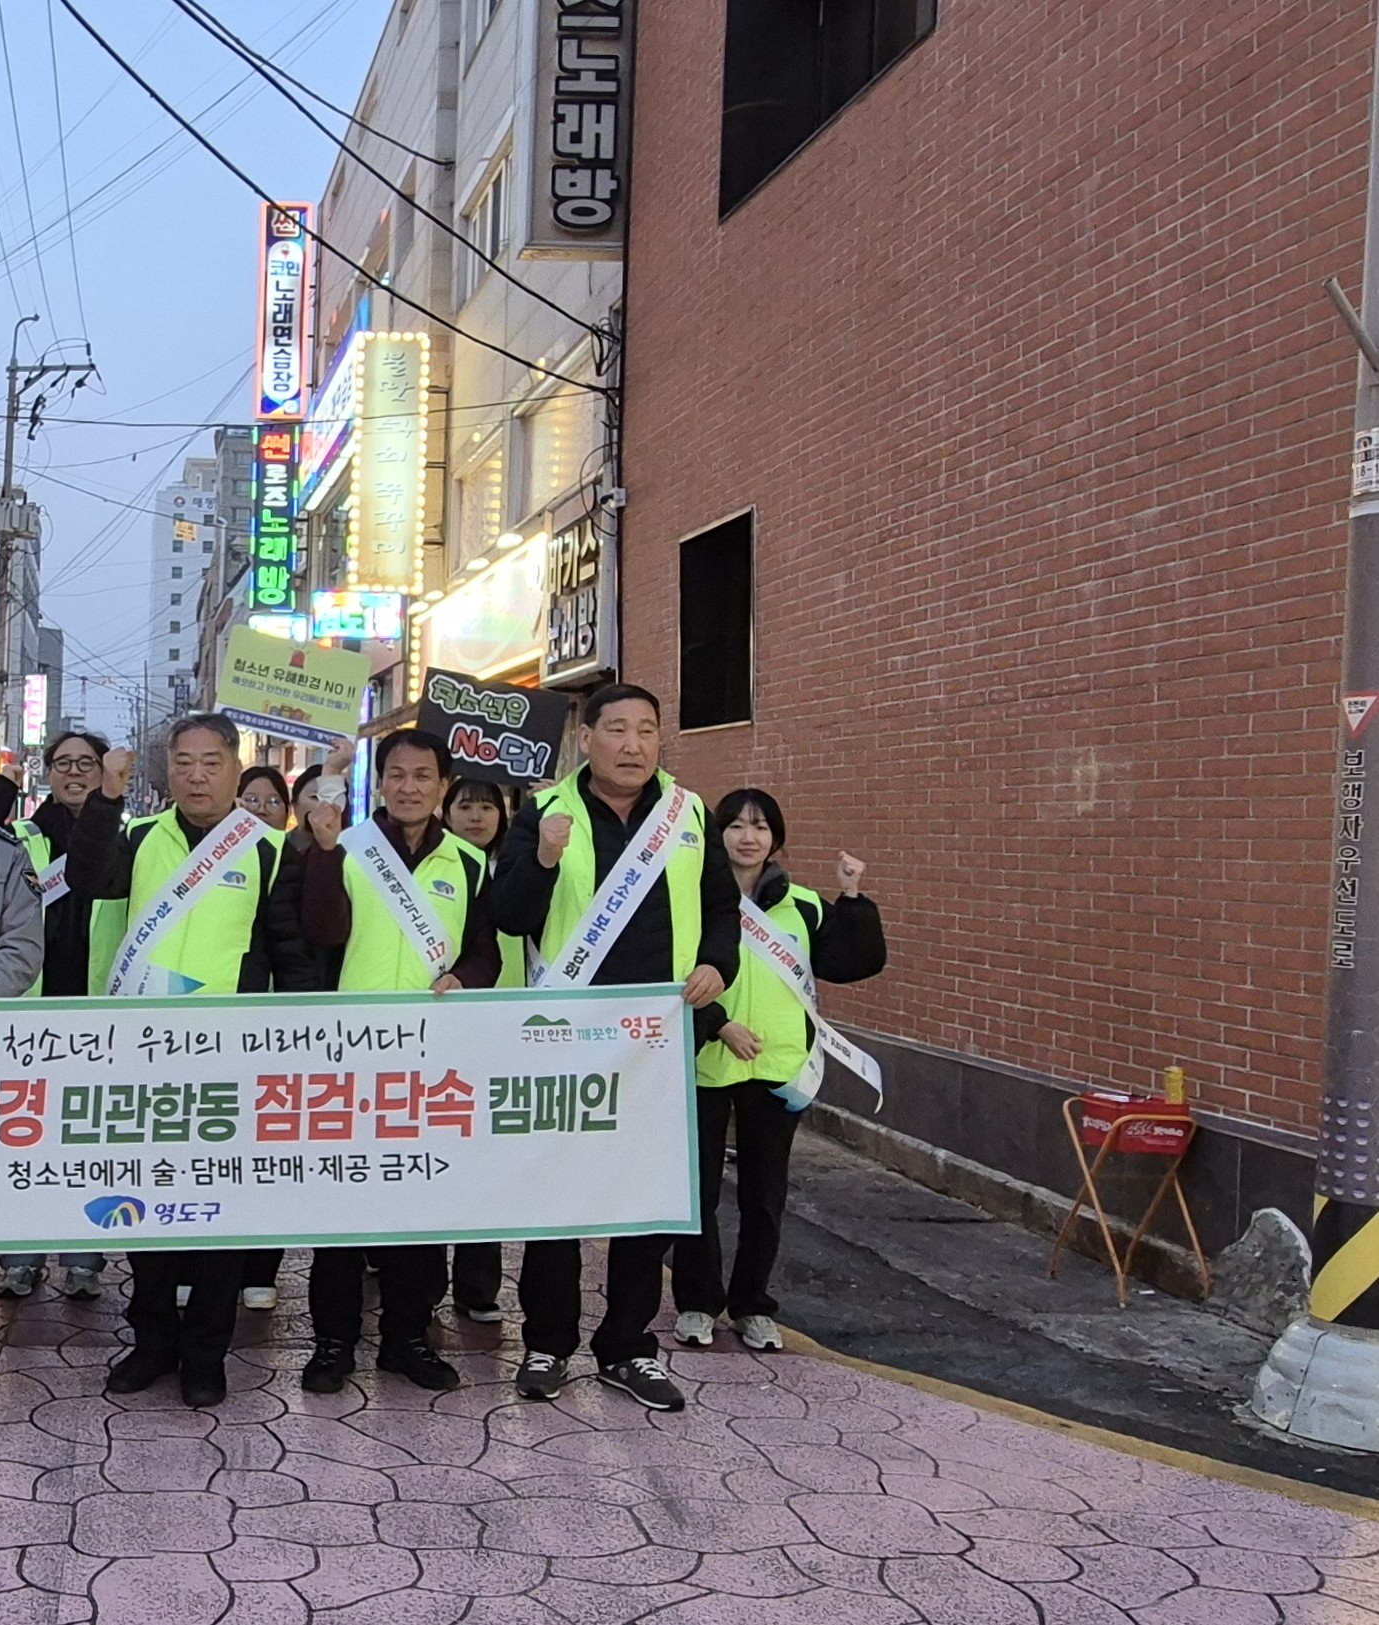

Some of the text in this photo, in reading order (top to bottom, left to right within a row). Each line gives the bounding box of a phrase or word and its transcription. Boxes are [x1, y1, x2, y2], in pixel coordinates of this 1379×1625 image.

[270, 260, 300, 277] 코인
[272, 280, 296, 391] 노래연습장
[233, 658, 270, 678] 청소년
[324, 680, 344, 695] NO
[431, 678, 527, 725] 청소년은
[637, 822, 670, 866] 근절로
[1331, 750, 1365, 969] 보행자우선도로
[172, 858, 213, 900] 근절로
[606, 869, 641, 913] 청소년
[135, 901, 172, 945] 청소년
[583, 914, 610, 946] 보호
[426, 941, 445, 962] 117
[563, 946, 590, 980] 강화
[3, 1023, 115, 1066] 청소년!
[136, 1025, 223, 1058] 우리의
[241, 1018, 427, 1062] 미래입니다!
[577, 1027, 618, 1041] 깨끗한
[620, 1016, 663, 1040] 영도
[61, 1082, 240, 1145] 민관합동
[254, 1069, 476, 1144] 점검·단속
[488, 1070, 620, 1135] 캠페인
[7, 1158, 142, 1188] 청소년에게
[151, 1157, 244, 1187] 술·담배
[251, 1154, 371, 1185] 판매·제공
[378, 1152, 451, 1182] 금지>
[153, 1201, 222, 1225] 영도구
